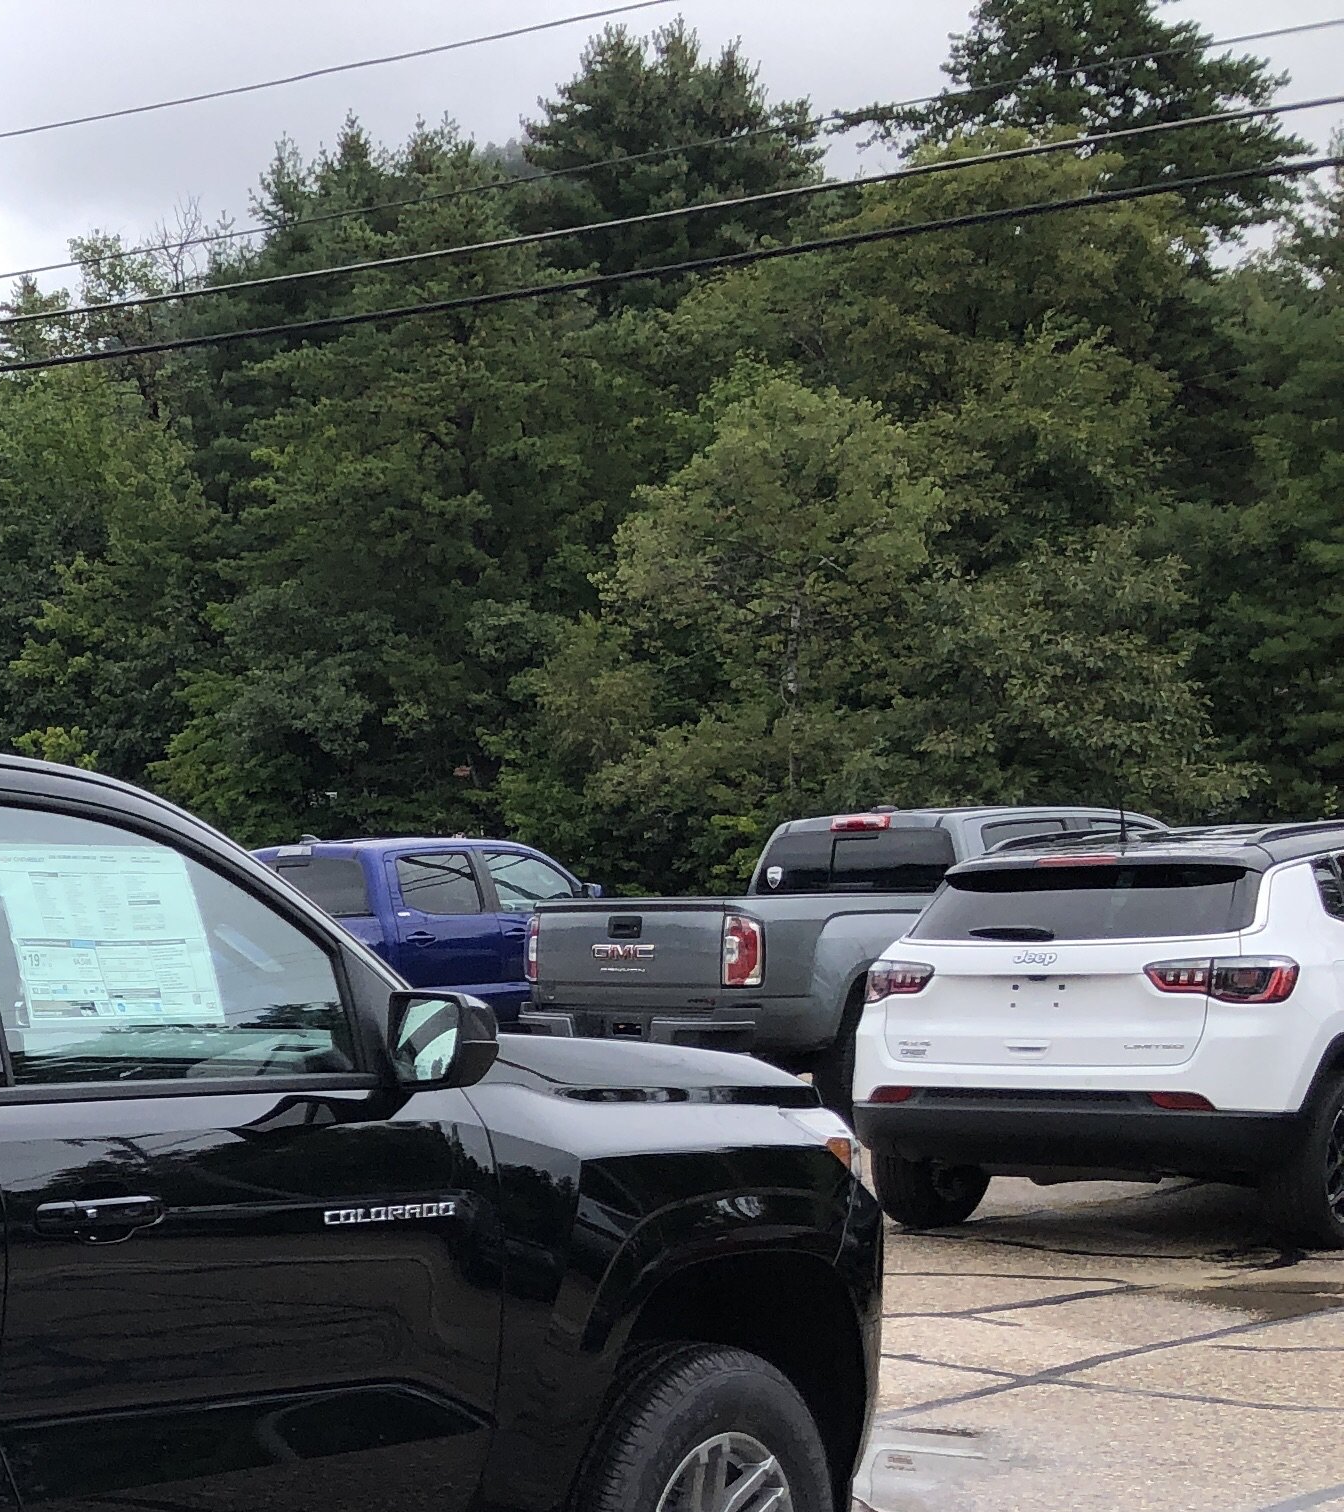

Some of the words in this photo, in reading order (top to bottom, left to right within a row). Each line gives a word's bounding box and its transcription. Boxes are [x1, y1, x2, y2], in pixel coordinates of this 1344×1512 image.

[591, 943, 656, 960] GMC
[1013, 949, 1058, 967] Jeep
[323, 1201, 455, 1225] COLORADO
